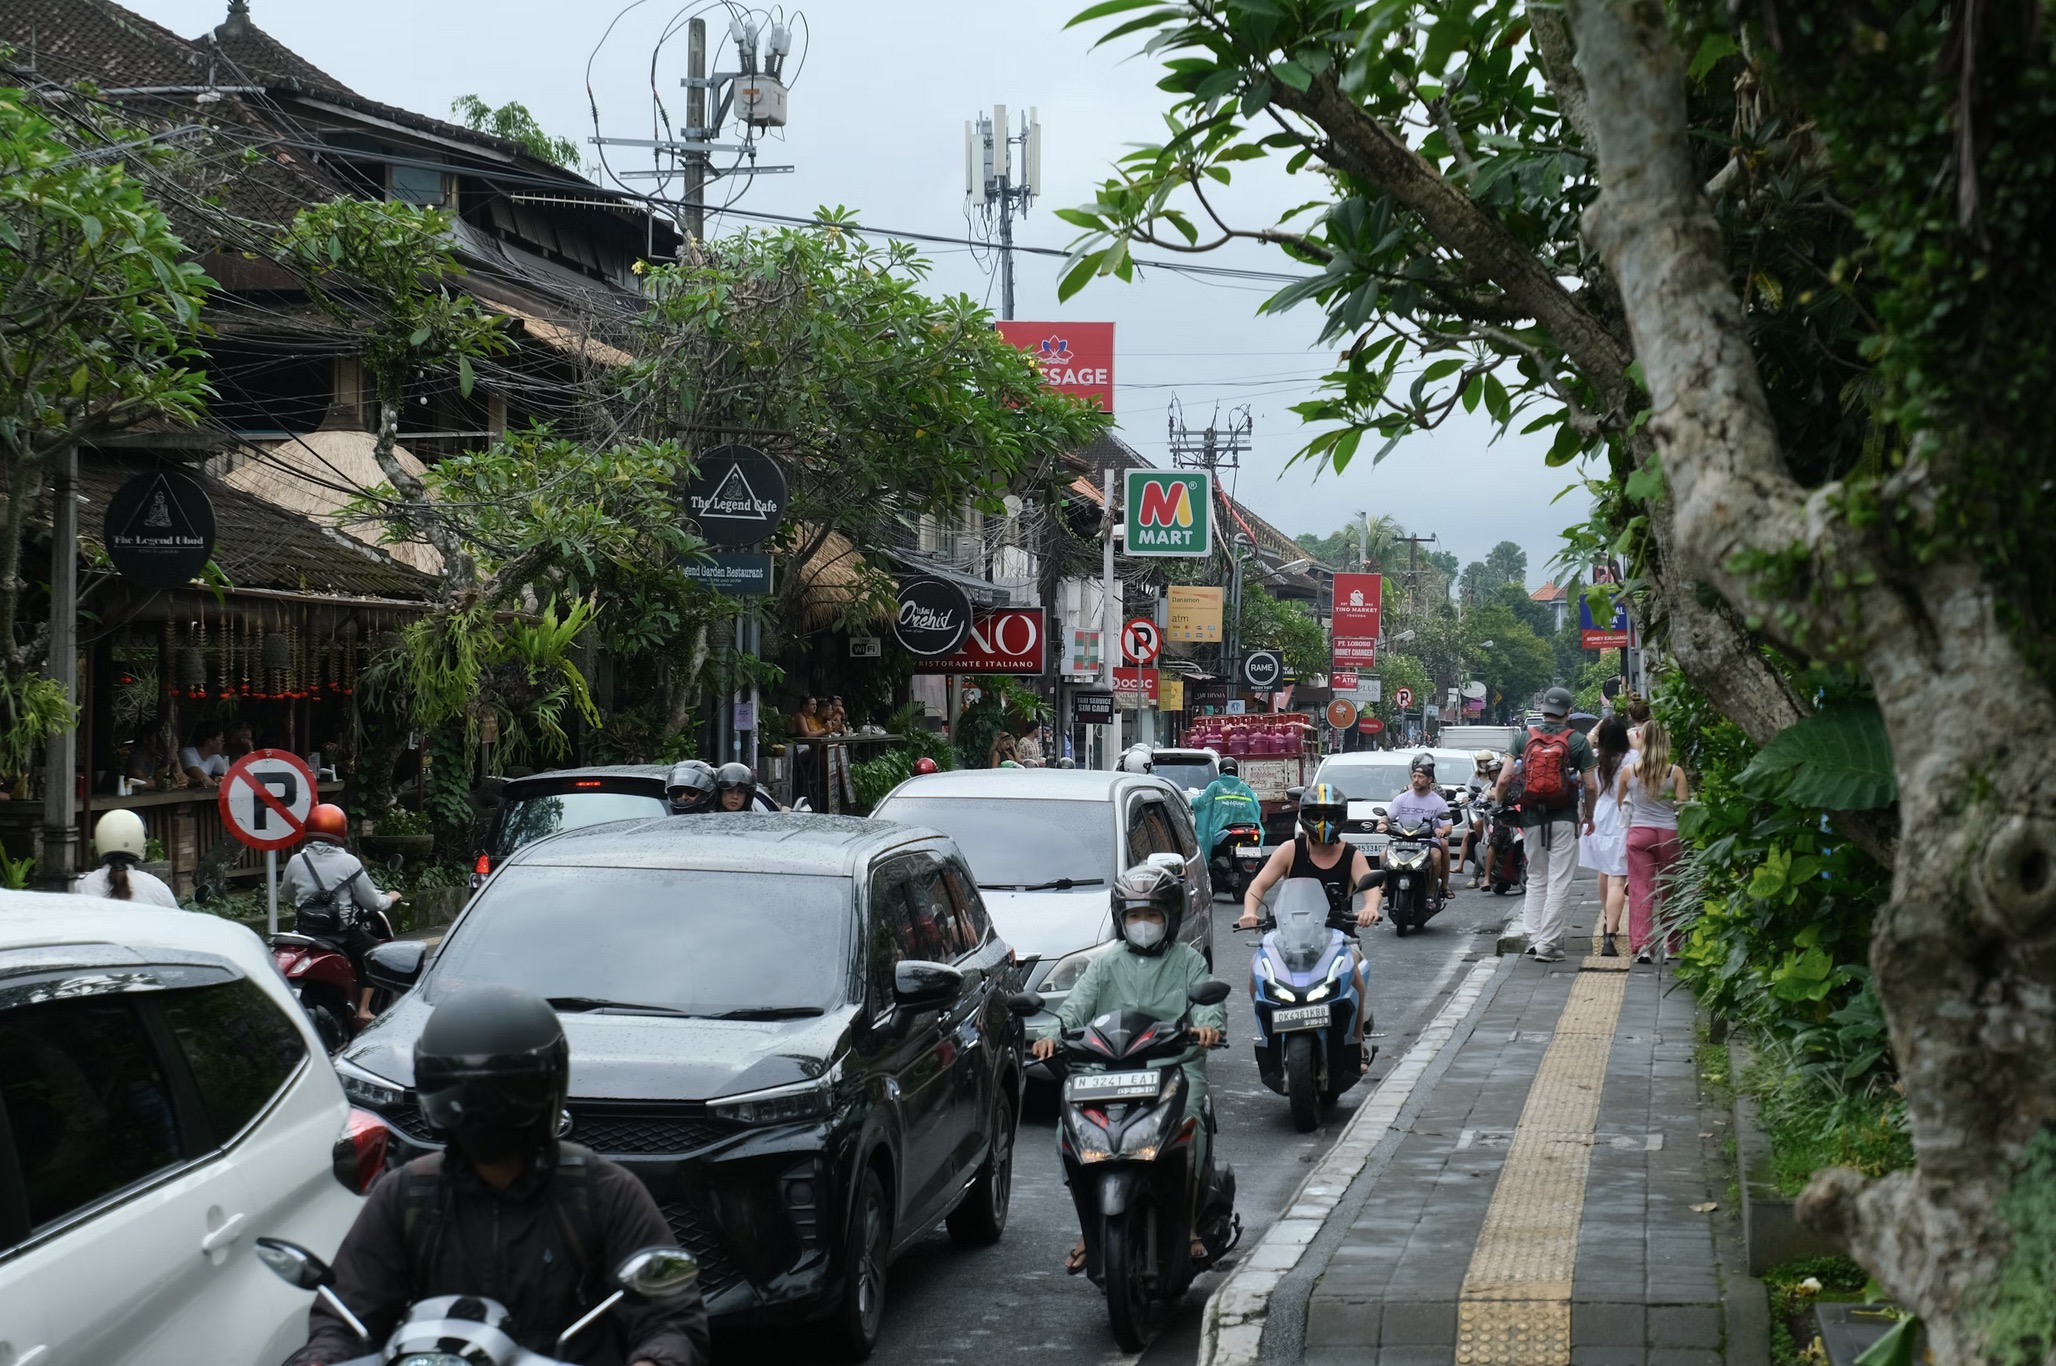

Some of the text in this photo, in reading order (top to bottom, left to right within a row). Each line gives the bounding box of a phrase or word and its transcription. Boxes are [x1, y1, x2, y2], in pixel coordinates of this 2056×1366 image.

[690, 496, 777, 513] The Legend Cafe
[112, 535, 204, 546] The Legend Ubud
[1138, 529, 1193, 545] MART
[701, 565, 726, 578] Garden
[726, 566, 764, 579] Restaurant
[898, 600, 954, 629] Orchid
[1171, 614, 1189, 623] atm
[1133, 627, 1152, 656] P
[1334, 648, 1374, 657] MONEY CHANGER
[918, 660, 1033, 668] RISTORANTE ITALIANO
[1250, 663, 1273, 672] RAME
[1089, 697, 1111, 705] SERVICE
[1091, 705, 1110, 713] CARD
[253, 772, 297, 830] P
[1078, 1074, 1158, 1087] N 3241 EAT
